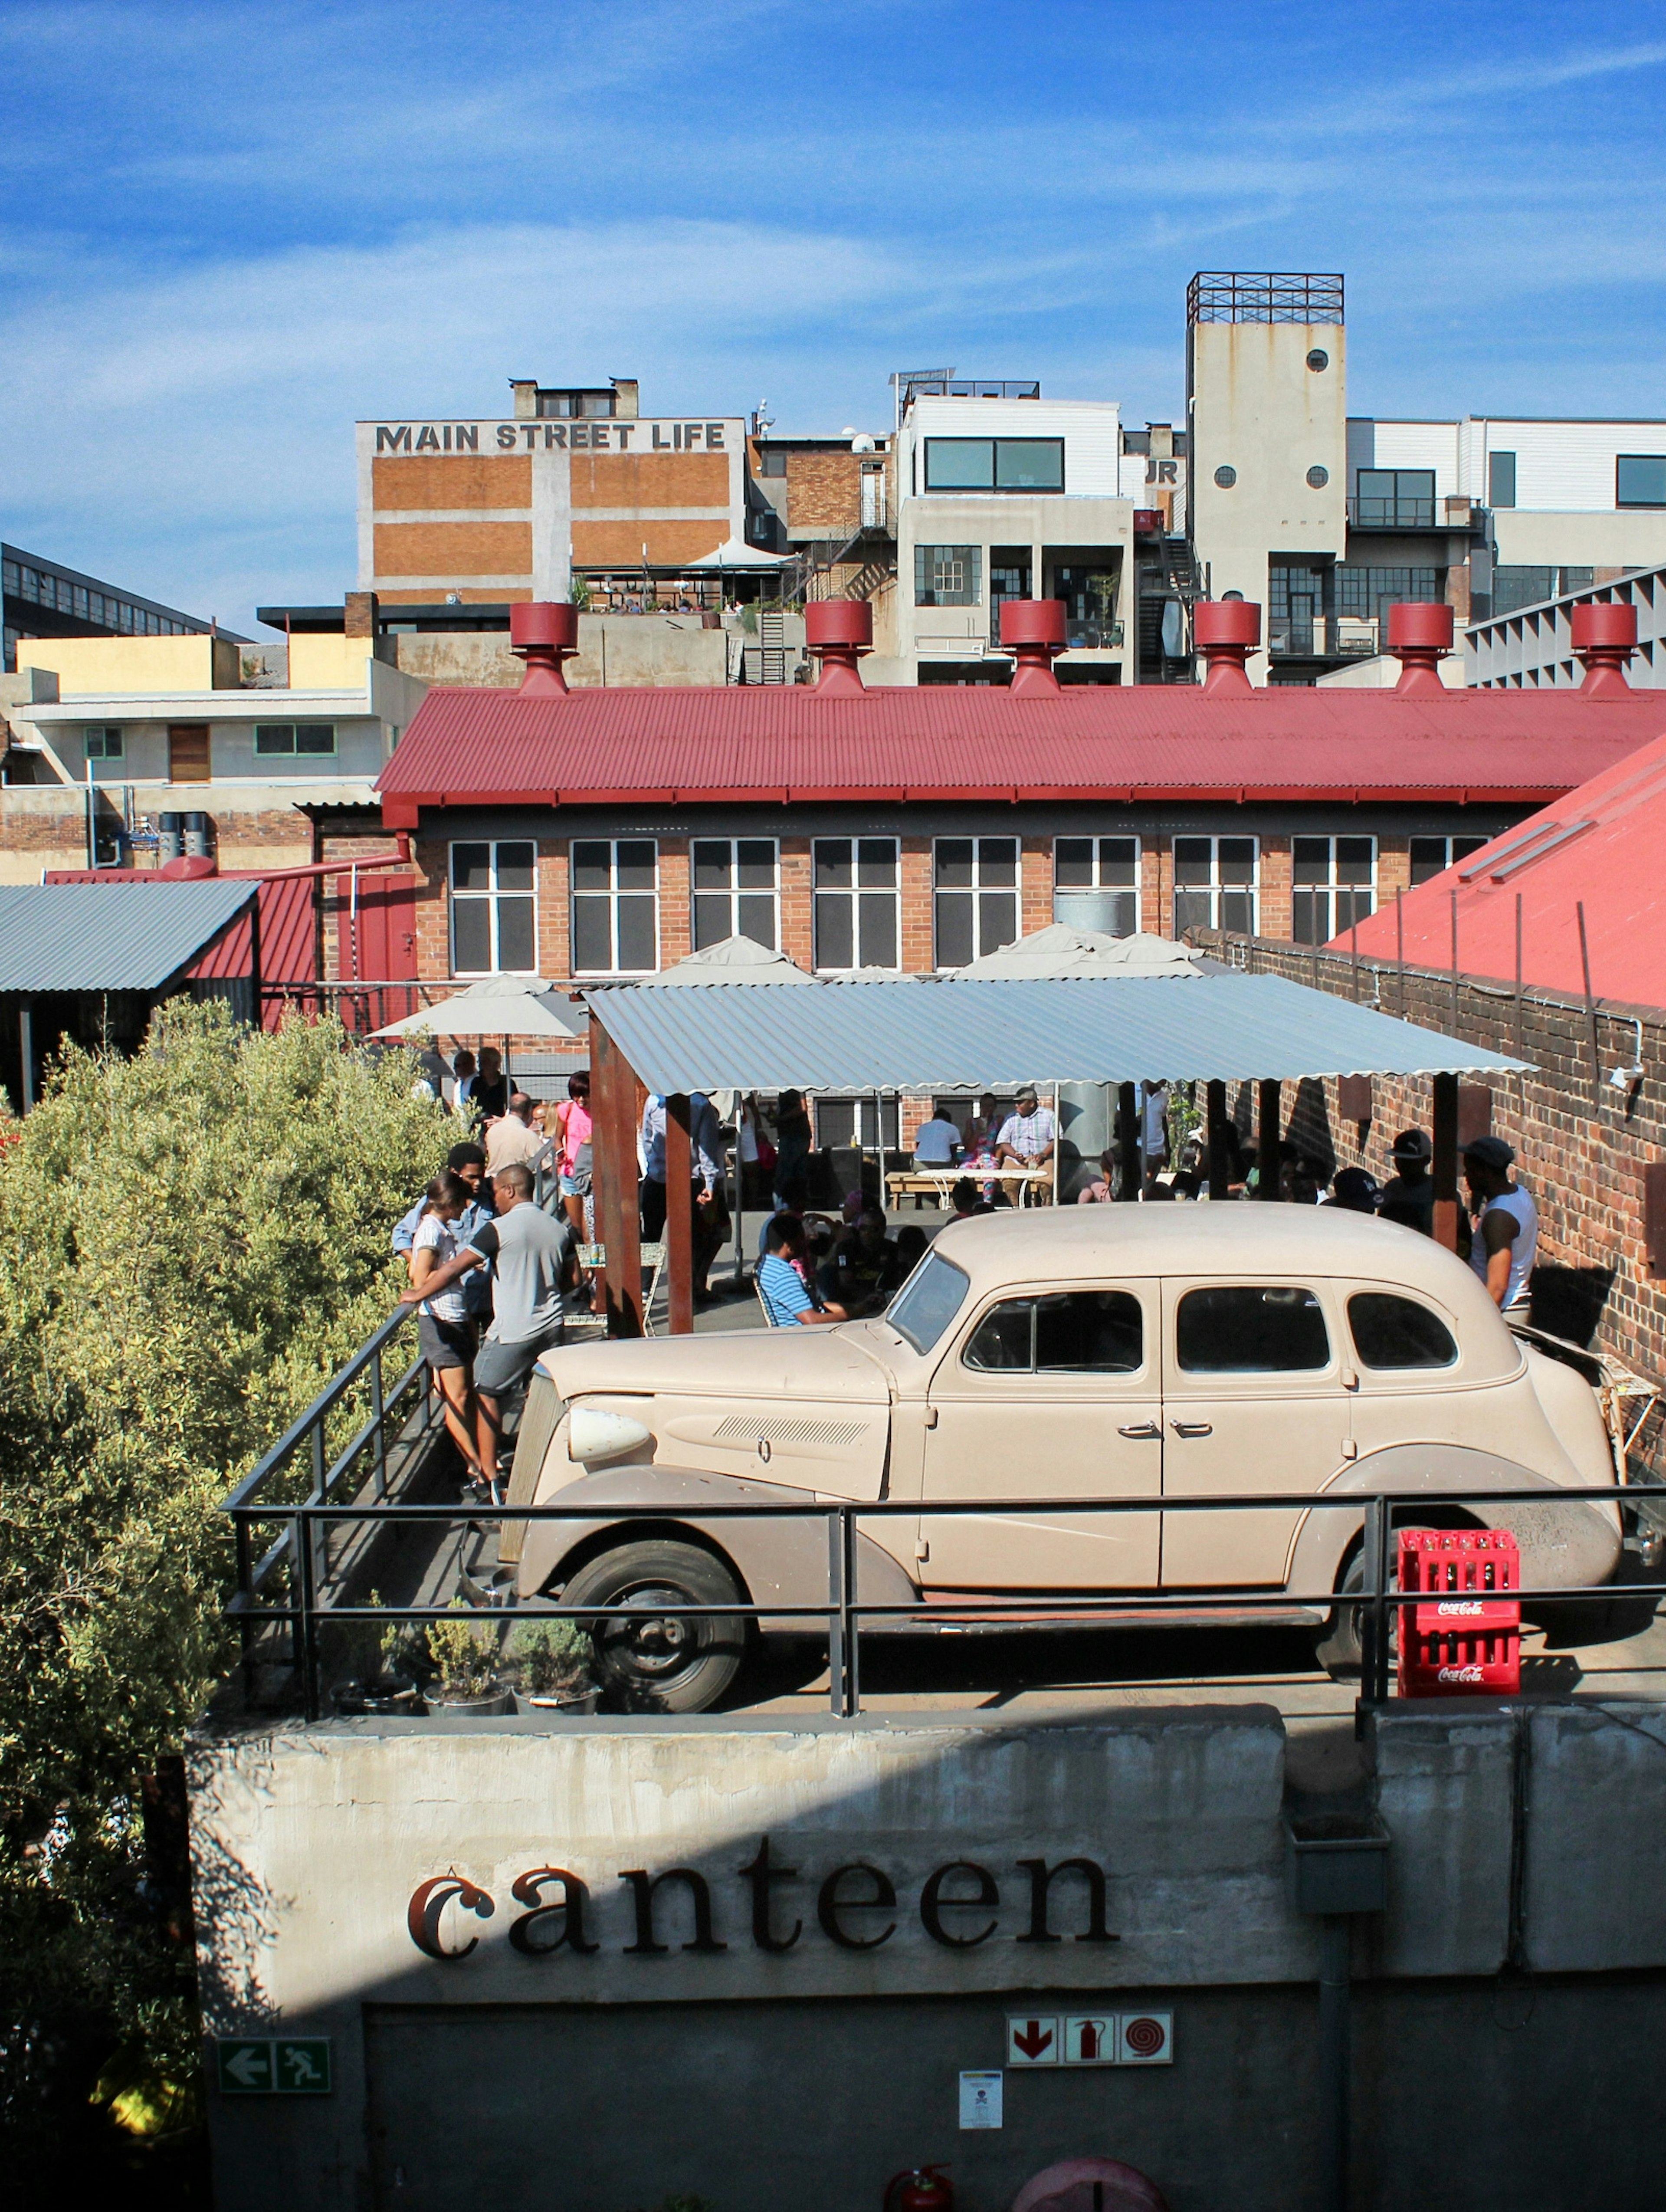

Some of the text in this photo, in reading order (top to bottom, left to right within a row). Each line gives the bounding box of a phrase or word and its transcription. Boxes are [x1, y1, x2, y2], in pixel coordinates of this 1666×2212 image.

[377, 423, 724, 452] MAIN STREET LIFE
[1438, 1666, 1484, 1682] Coca-Cola
[408, 1835, 1121, 1960] canteen
